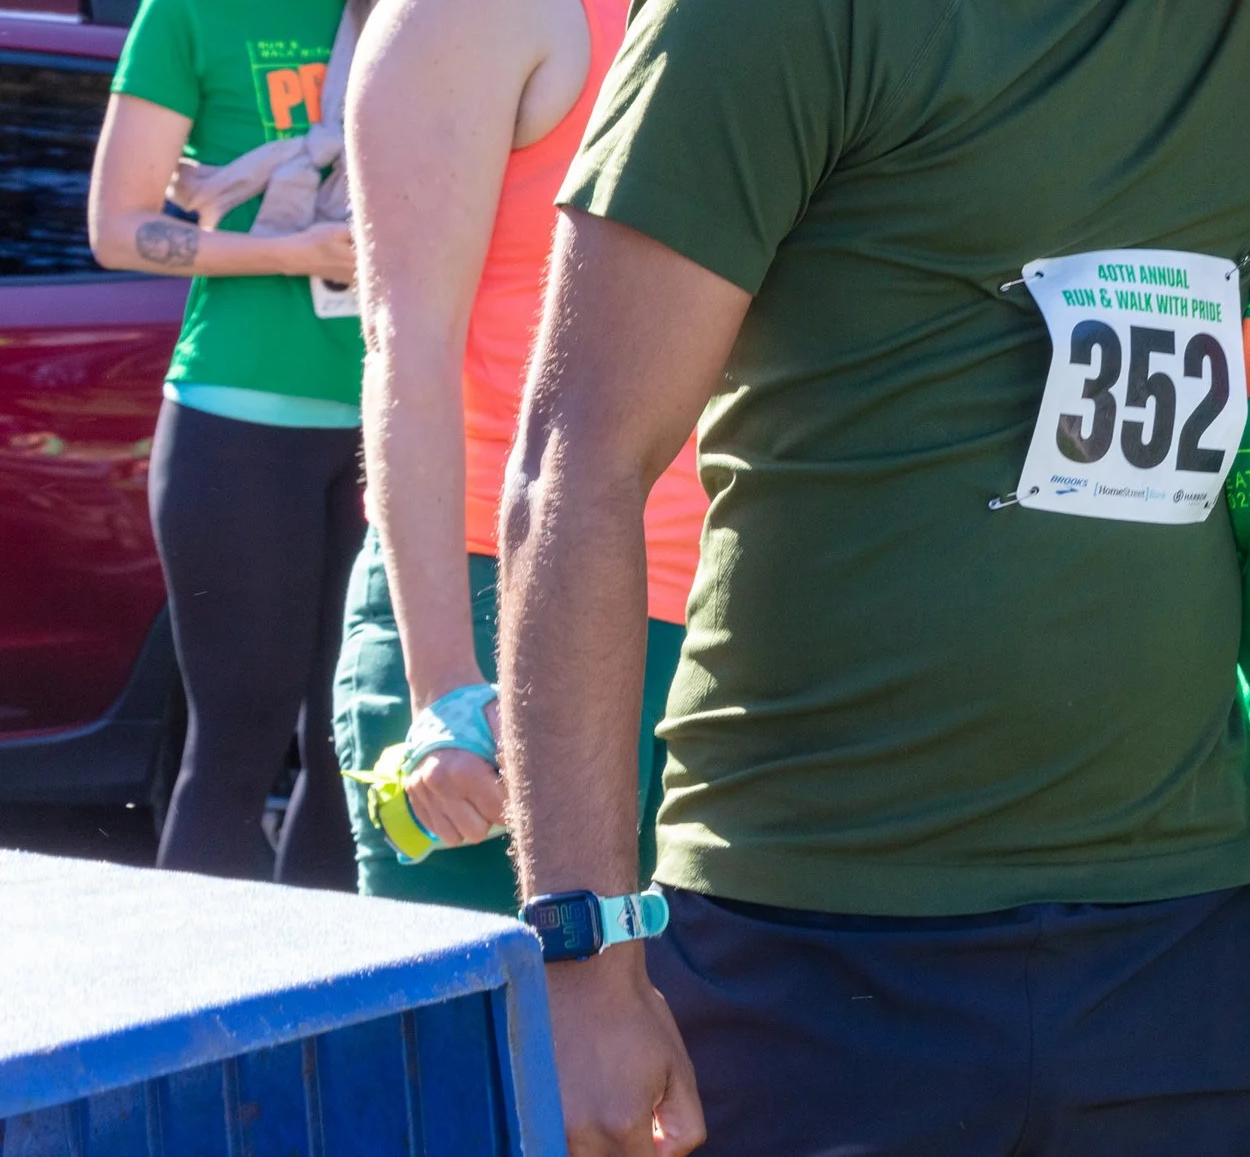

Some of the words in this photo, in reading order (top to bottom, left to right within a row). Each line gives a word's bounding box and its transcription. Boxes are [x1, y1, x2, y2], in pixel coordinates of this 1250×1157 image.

[1098, 264, 1135, 284] 40TH
[1140, 267, 1189, 289] ANNUAL
[1062, 289, 1096, 308] RUN
[1100, 289, 1112, 308] &
[1115, 290, 1153, 313] WALK
[1156, 294, 1188, 318] WITH
[1191, 300, 1222, 323] PRIDE
[1055, 319, 1230, 473] 352
